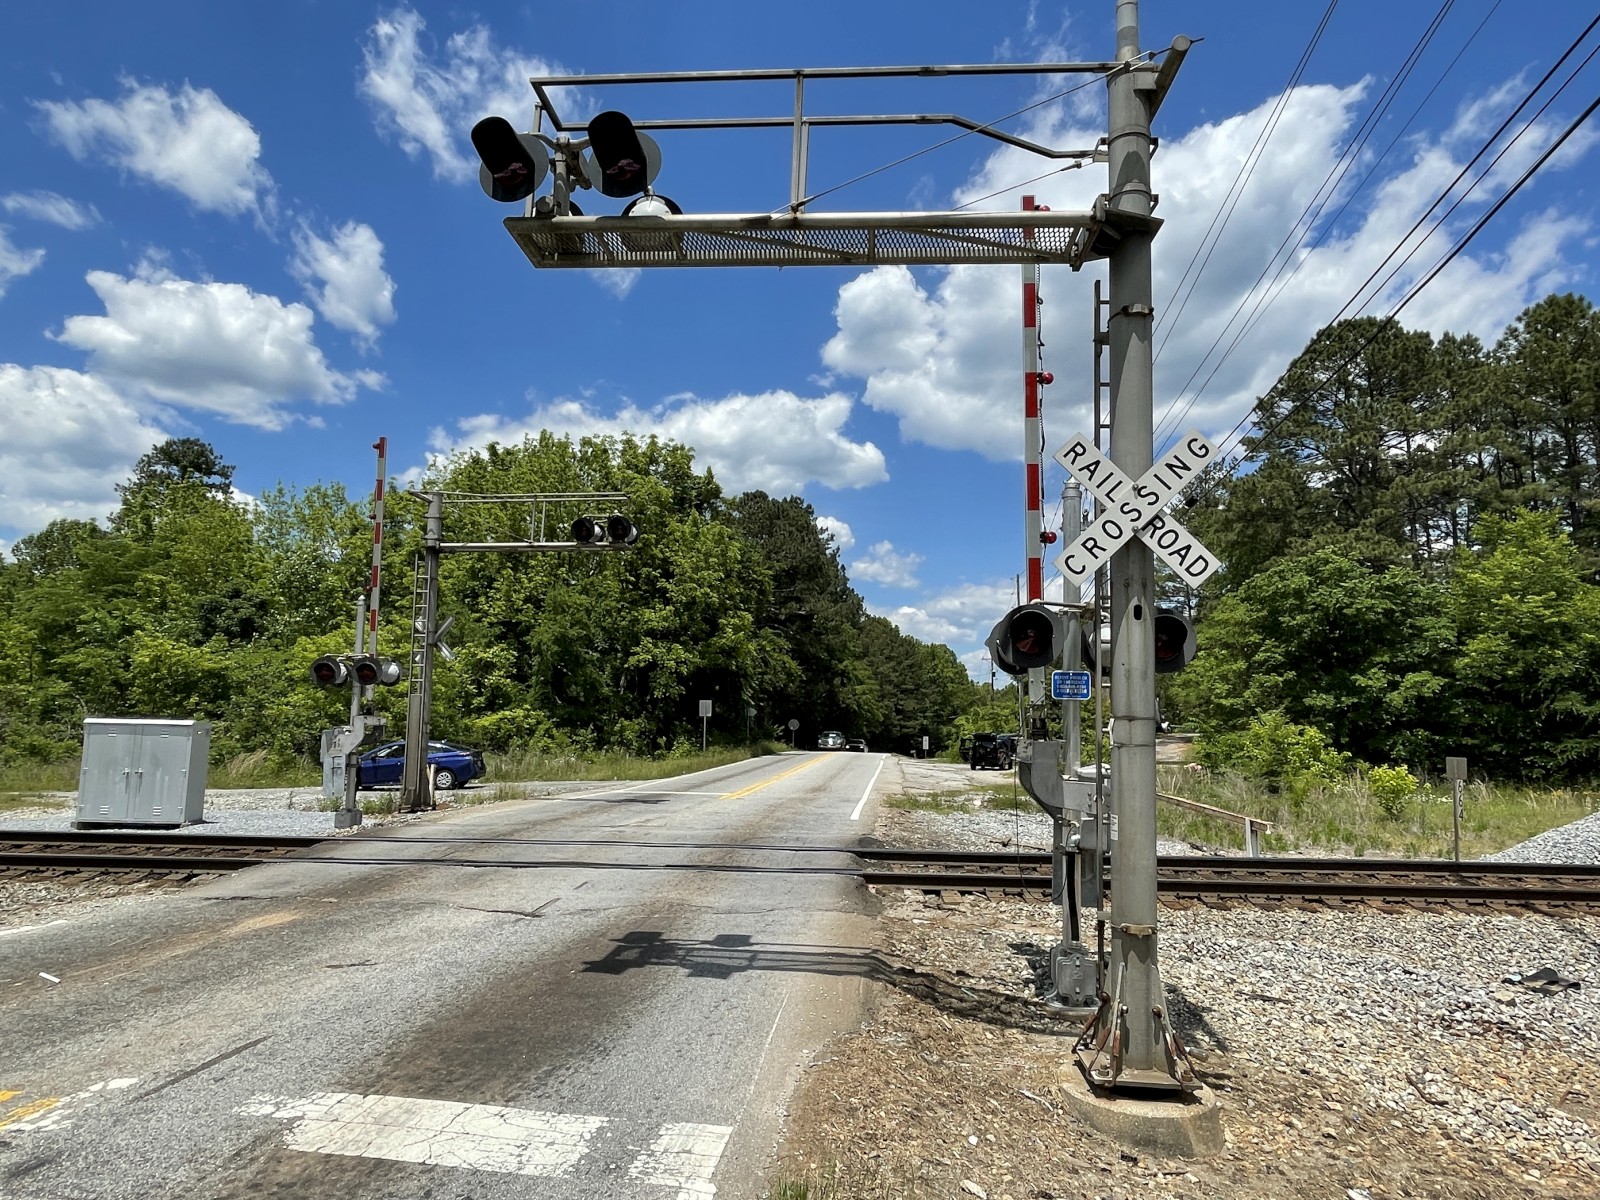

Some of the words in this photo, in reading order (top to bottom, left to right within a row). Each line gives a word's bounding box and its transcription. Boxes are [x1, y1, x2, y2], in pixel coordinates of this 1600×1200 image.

[1063, 441, 1123, 503] RAIL
[1141, 514, 1209, 577] ROAD
[1064, 438, 1210, 575] CROSSING
